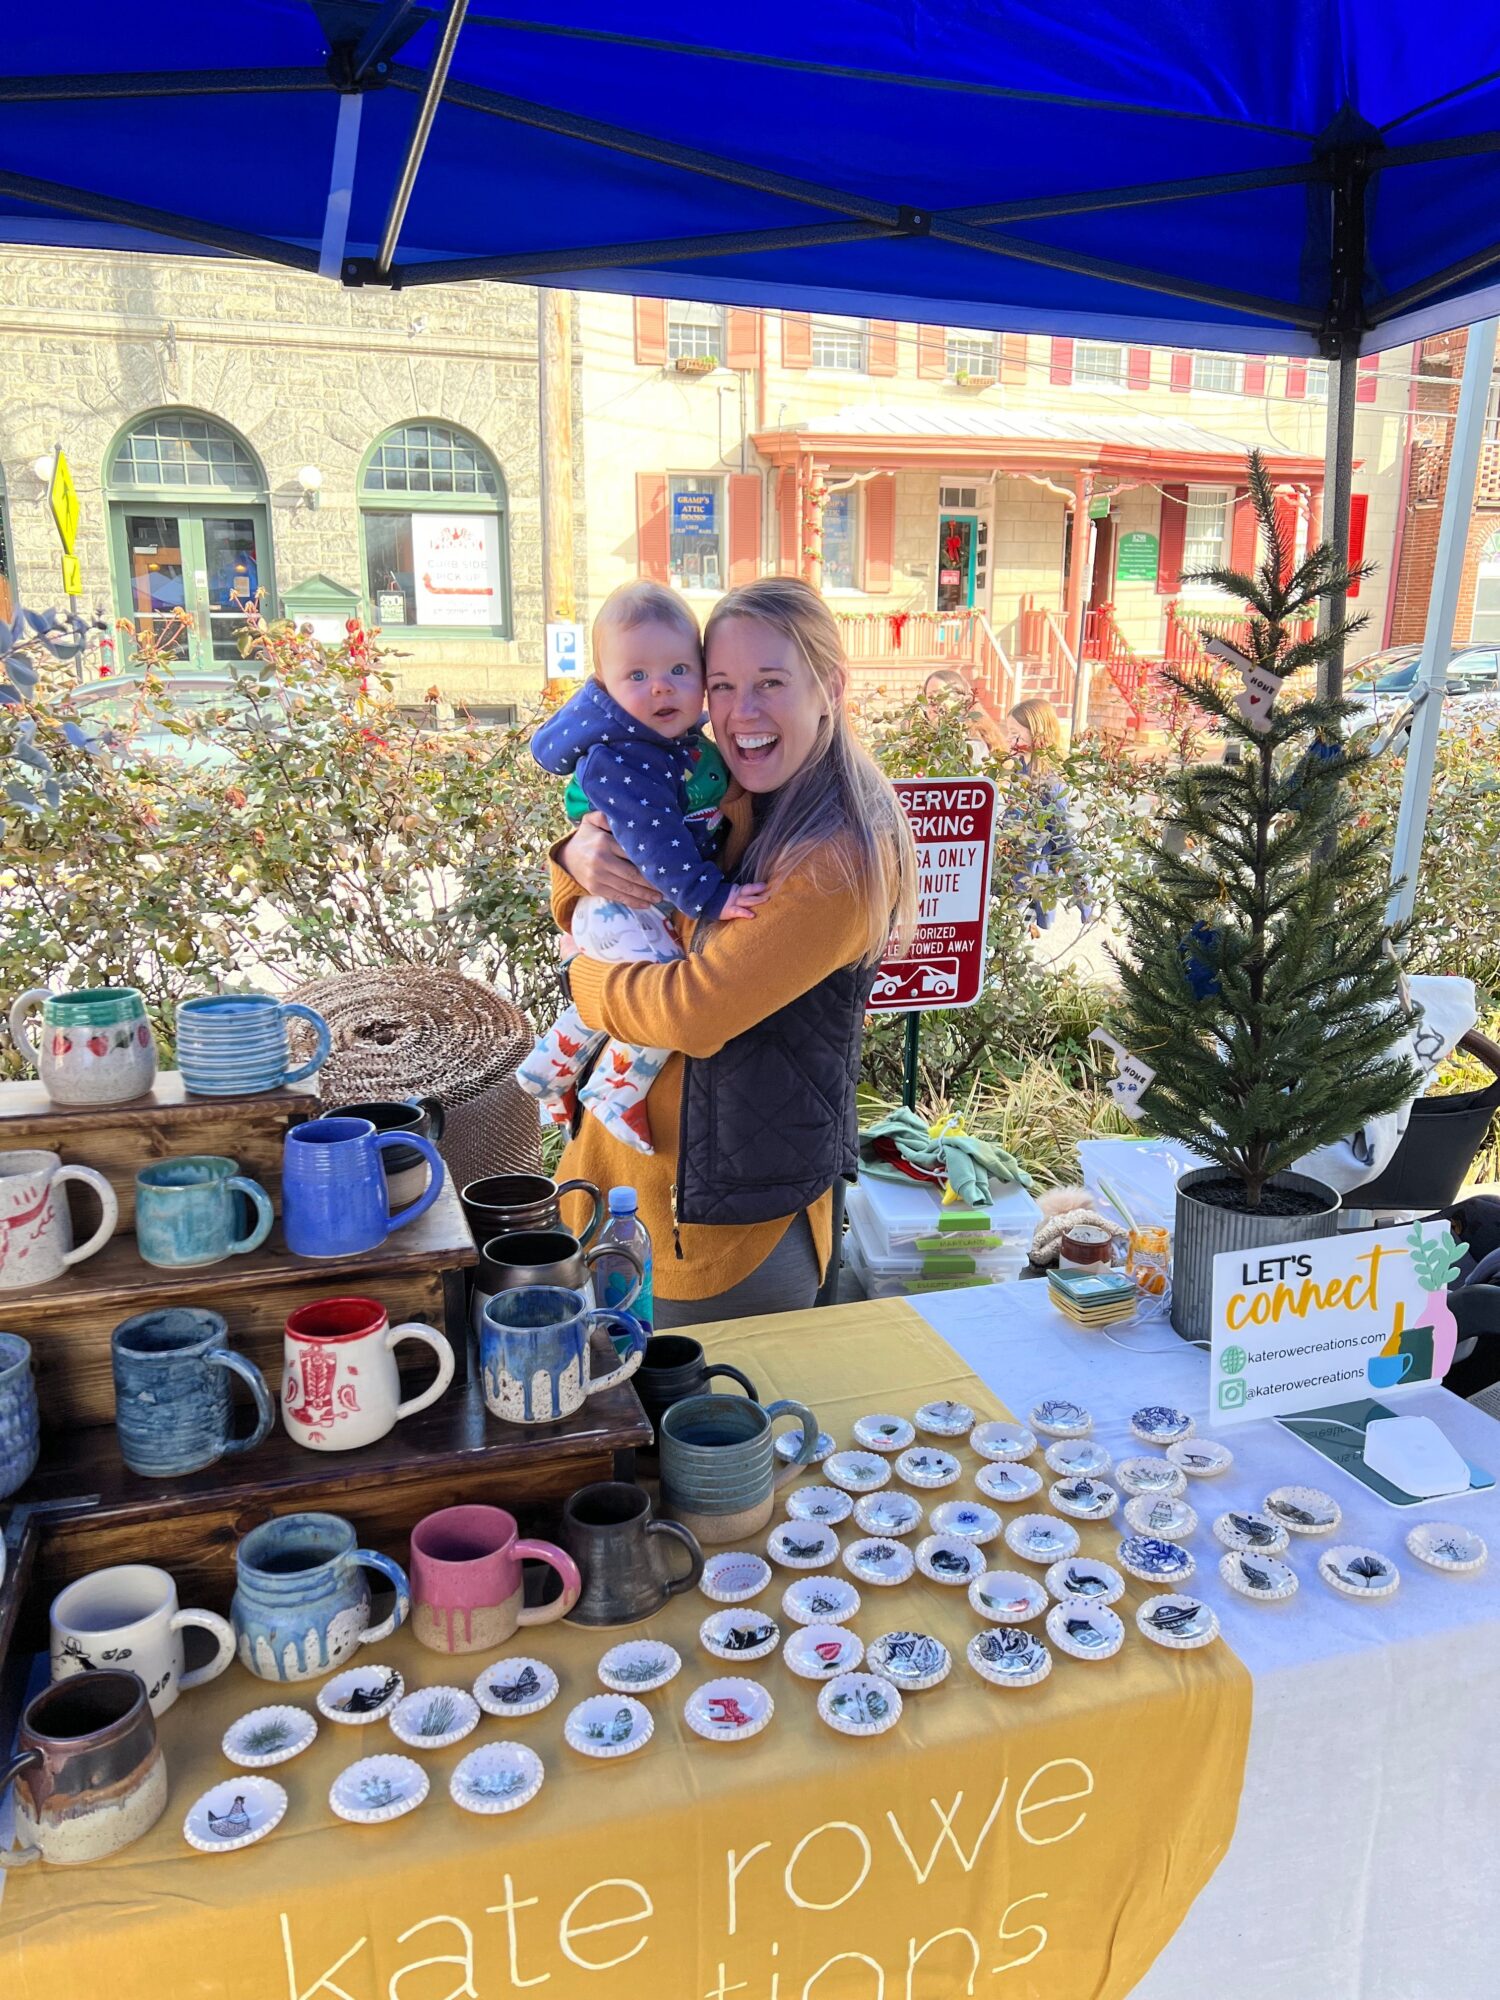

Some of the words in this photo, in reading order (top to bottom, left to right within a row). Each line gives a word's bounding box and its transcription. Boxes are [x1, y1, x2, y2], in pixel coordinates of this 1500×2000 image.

[462, 560, 488, 569] SIDE
[1250, 677, 1275, 695] HOME
[895, 789, 987, 811] SERVED
[909, 815, 975, 837] RKING
[938, 848, 977, 868] ONLY
[918, 873, 961, 894] INUTE
[918, 898, 939, 918] MIT
[911, 941, 944, 955] TOWED
[947, 940, 975, 953] AWAY
[1124, 1066, 1147, 1084] HOME
[1242, 1254, 1313, 1286] LET'S
[1226, 1244, 1410, 1331] connect
[1248, 1332, 1387, 1363] katerowecreations.com
[1246, 1367, 1365, 1400] @katerowecreations
[727, 1758, 1094, 1935] rowe
[280, 1873, 654, 2000] kate
